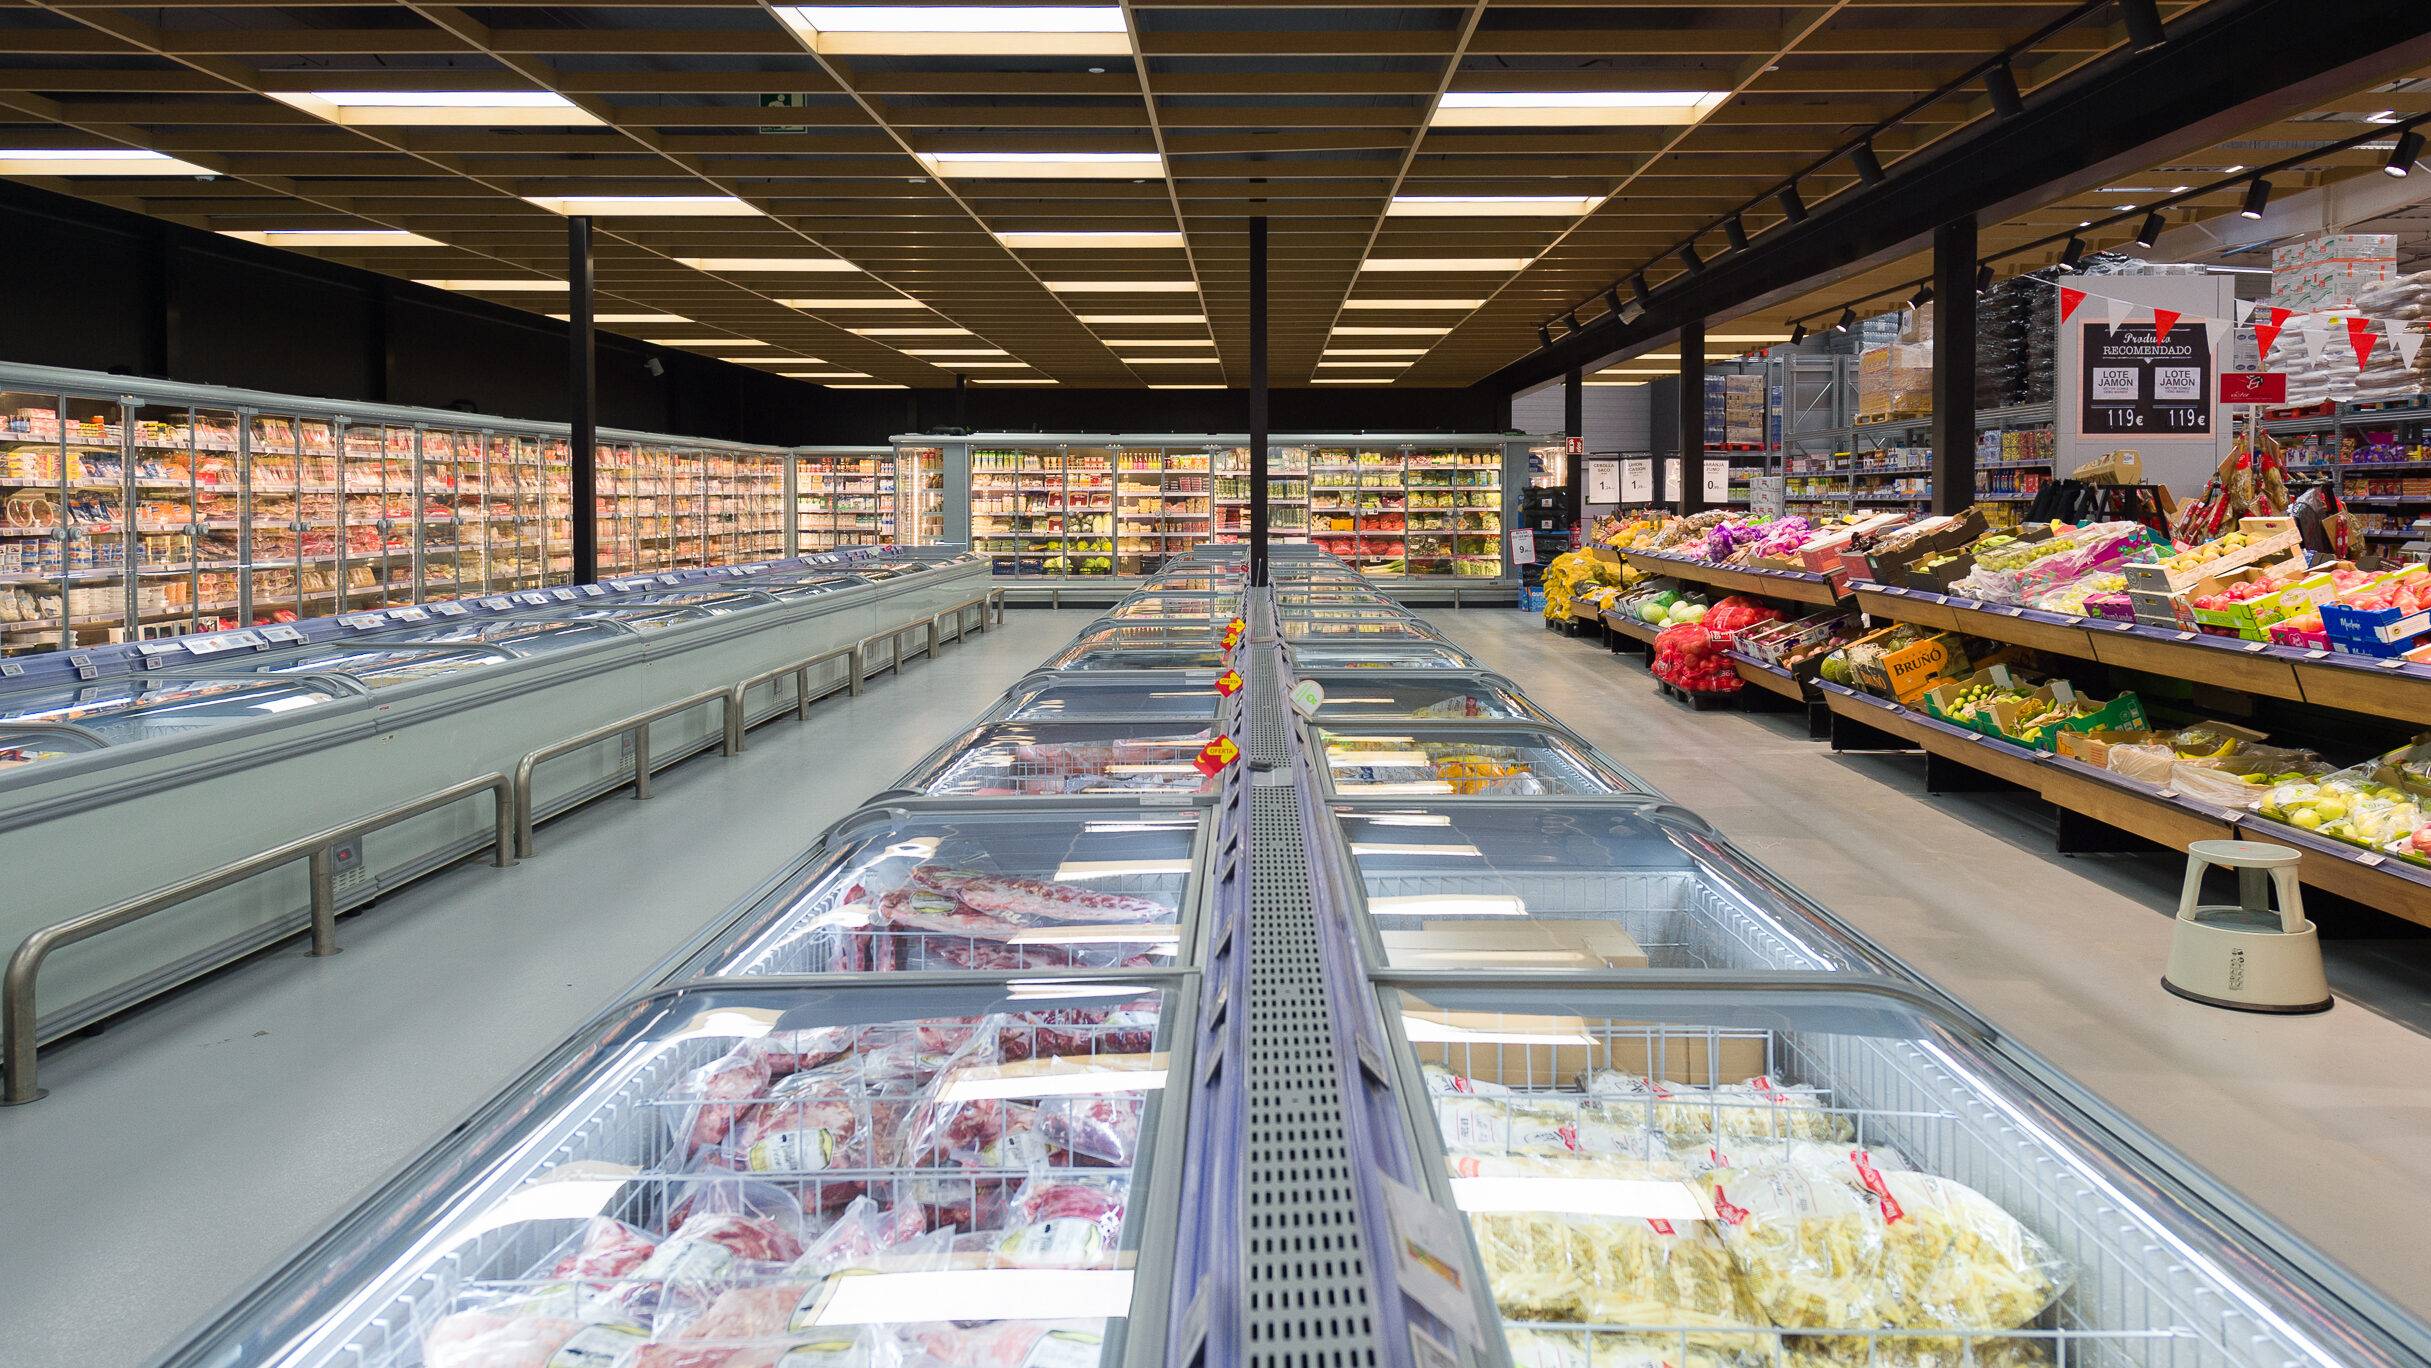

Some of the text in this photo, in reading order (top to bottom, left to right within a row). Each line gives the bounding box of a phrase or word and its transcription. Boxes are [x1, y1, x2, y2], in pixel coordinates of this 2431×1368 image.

[2123, 332, 2171, 344] Produto
[2102, 345, 2192, 355] RECOMENDADO
[2103, 370, 2129, 379] LOTE
[2164, 370, 2191, 379] LOTE
[2098, 378, 2134, 387] JAMON
[2160, 378, 2196, 387] JAMON
